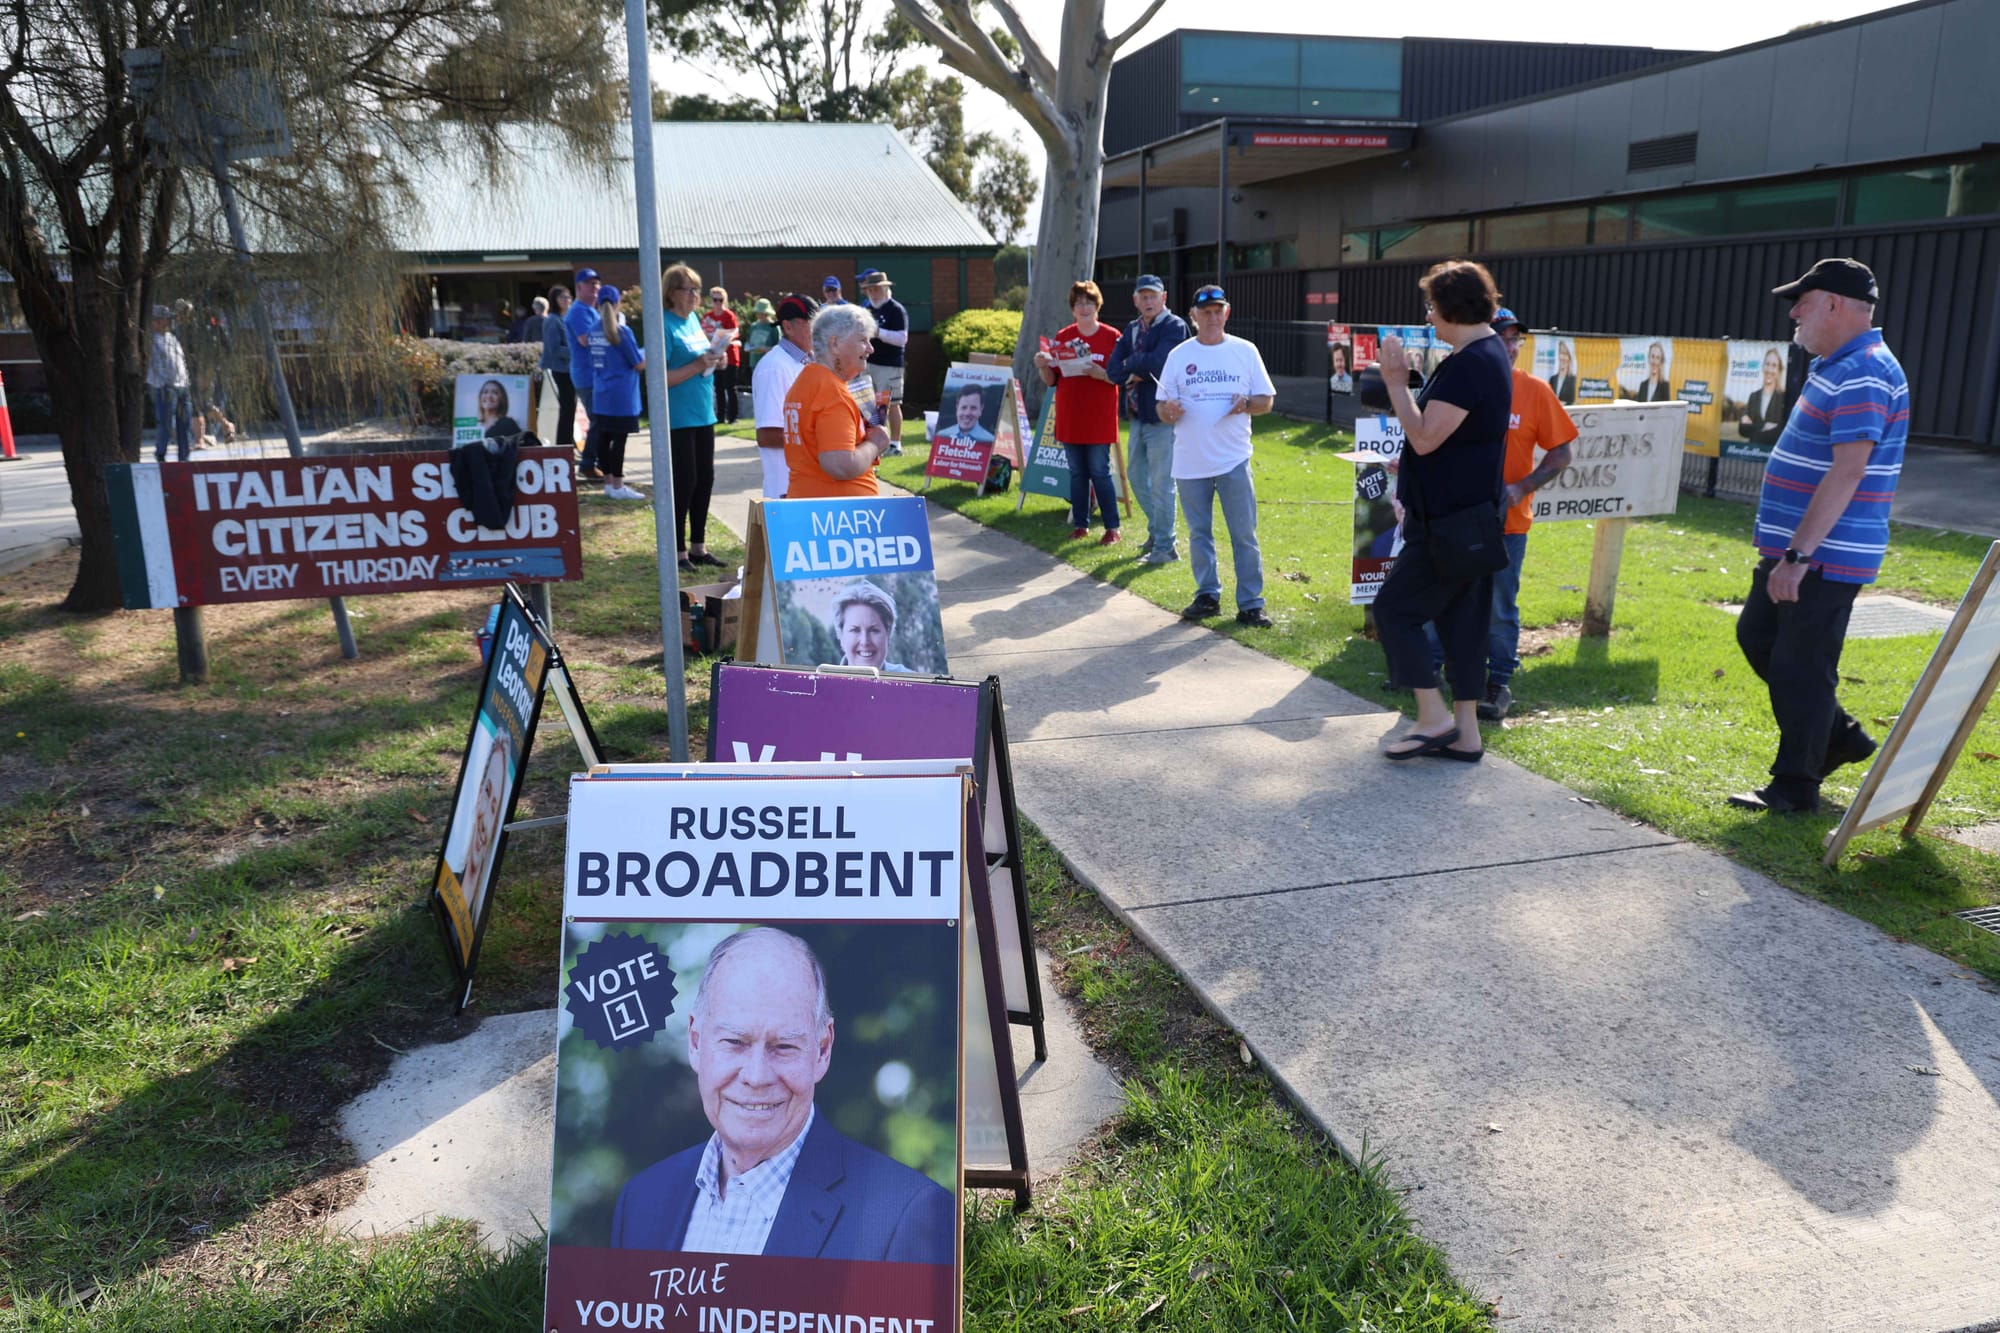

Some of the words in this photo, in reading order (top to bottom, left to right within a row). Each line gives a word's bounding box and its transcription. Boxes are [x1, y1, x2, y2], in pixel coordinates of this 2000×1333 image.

[1254, 135, 1297, 145] AMBULANCE
[1299, 135, 1320, 146] ENTRY
[1321, 136, 1340, 146] ONLY
[1344, 137, 1363, 146] KEEP
[1364, 137, 1388, 146] CLEAR
[1185, 375, 1241, 386] BROADBENT
[1197, 369, 1227, 377] RUSSELL
[456, 429, 482, 440] STEPH
[950, 434, 977, 450] Tully
[1576, 432, 1655, 459] IZENS
[938, 444, 983, 460] Fletcher
[1034, 458, 1069, 470] AUSTRALIA
[193, 464, 394, 511] ITALIAN
[411, 458, 572, 501] SEOR
[1358, 471, 1384, 489] VOTE
[1556, 497, 1625, 516] PROJECT
[211, 510, 428, 556] CITIZENS
[811, 509, 886, 537] MARY
[784, 535, 922, 573] ALDRED
[220, 562, 299, 592] EVERY
[316, 554, 440, 586] THURSDAY
[1360, 571, 1385, 582] YOUR
[505, 618, 530, 668] Deb
[670, 805, 857, 841] RUSSELL
[577, 850, 954, 898] BROADBENT
[575, 952, 660, 1003] VOTE
[615, 1002, 636, 1029] 1
[649, 1262, 730, 1299] TRUE
[575, 1300, 665, 1330] YOUR
